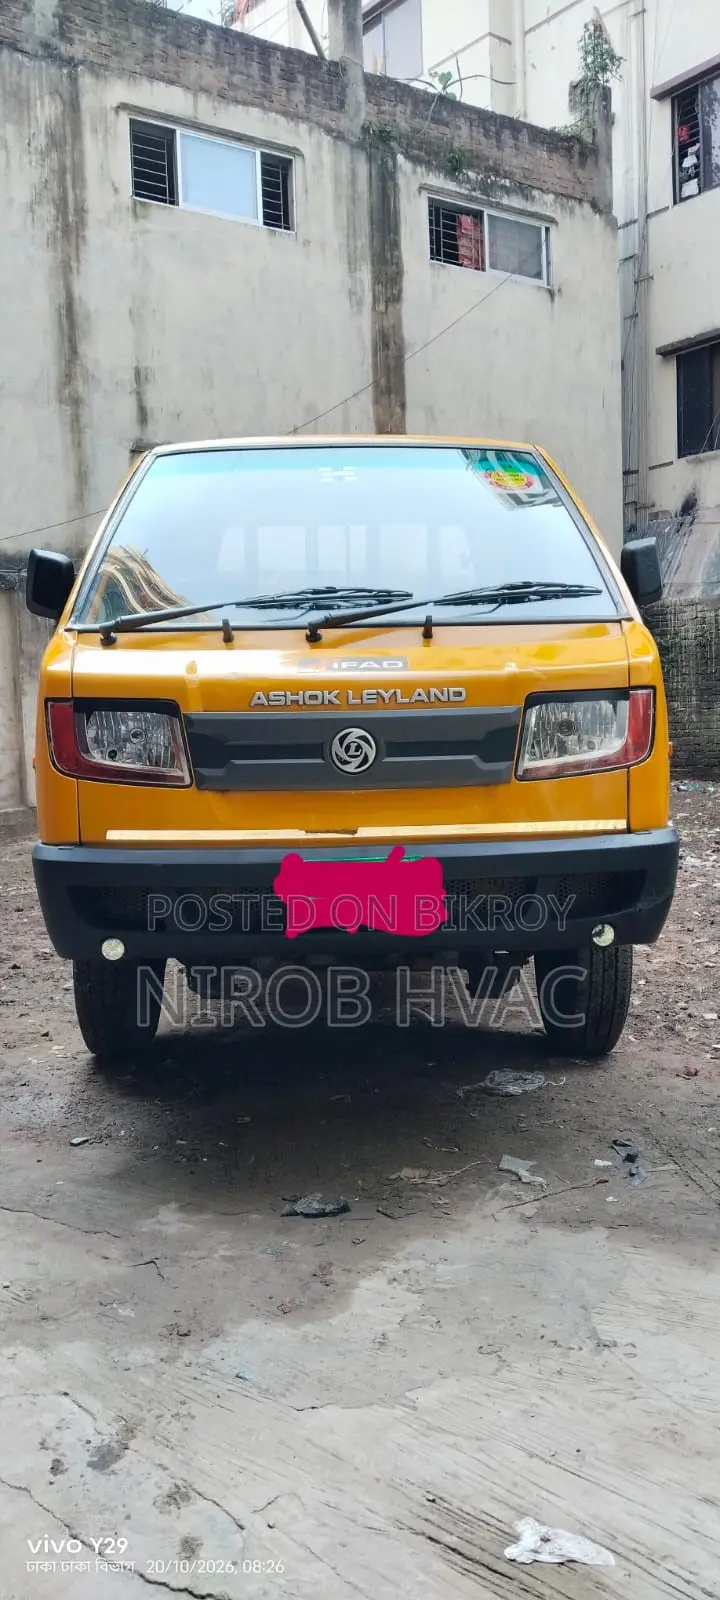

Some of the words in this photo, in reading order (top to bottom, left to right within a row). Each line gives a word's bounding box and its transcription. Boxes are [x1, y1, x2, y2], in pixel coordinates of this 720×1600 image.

[332, 660, 403, 669] IFAD
[250, 690, 341, 706] ASHOK
[347, 687, 467, 705] LEYLAND
